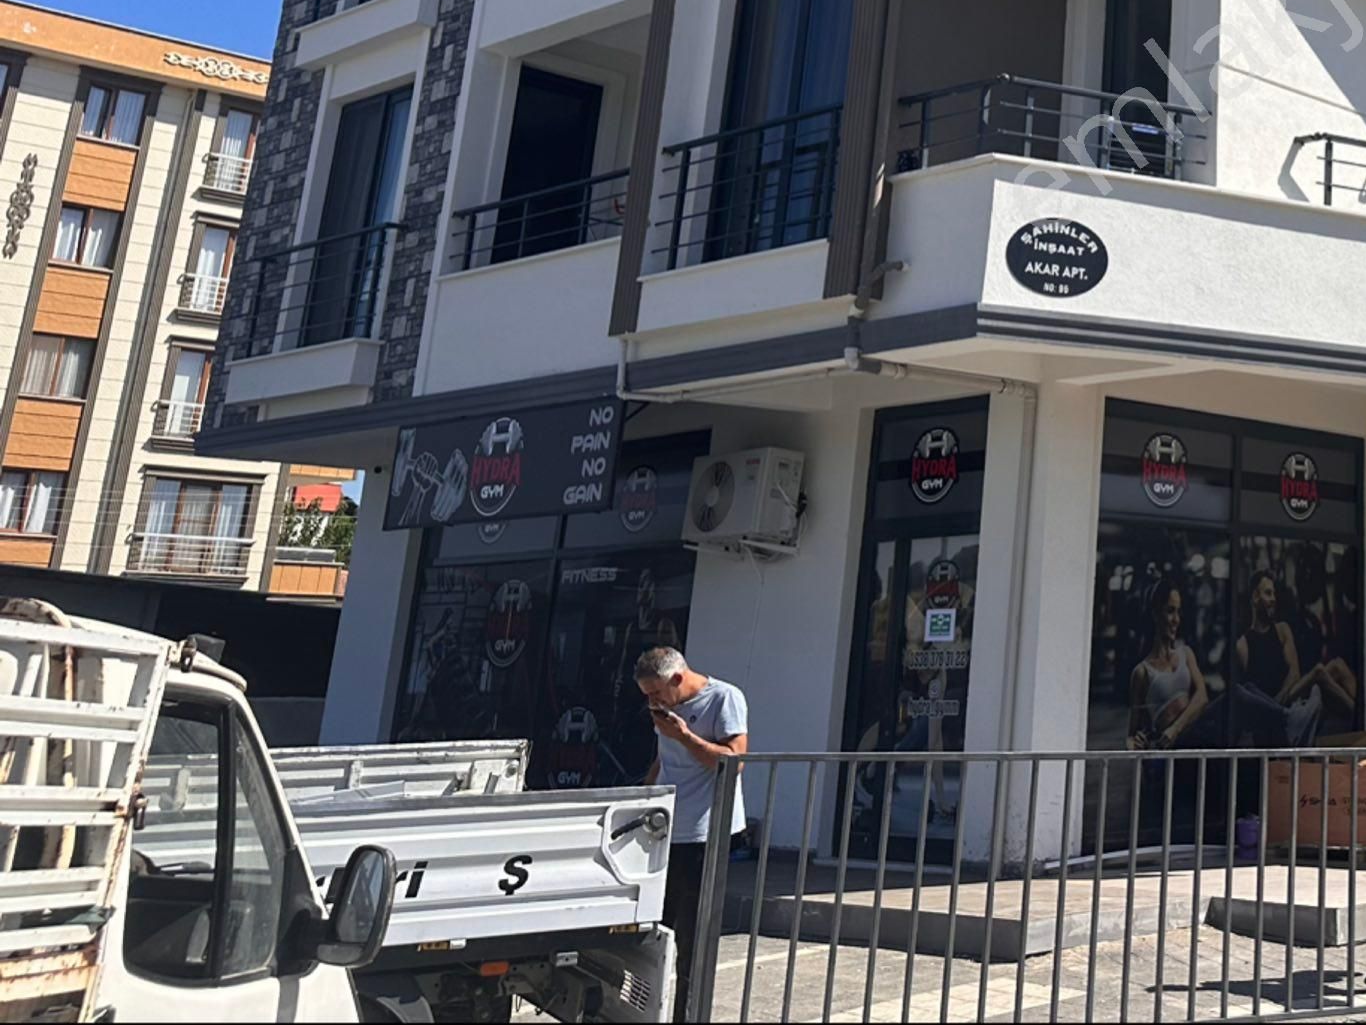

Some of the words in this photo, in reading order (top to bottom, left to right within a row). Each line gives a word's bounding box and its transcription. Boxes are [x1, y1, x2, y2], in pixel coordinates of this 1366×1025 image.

[1025, 262, 1060, 277] AKAR
[1062, 266, 1088, 280] APT.
[589, 406, 614, 427] NO
[570, 432, 611, 454] PAIN
[470, 453, 521, 486] HYDRA
[581, 457, 606, 477] NO
[912, 454, 958, 481] HYDRA
[1142, 458, 1188, 488] HYDRA
[480, 484, 504, 499] GYM
[921, 478, 943, 490] GYM
[1153, 482, 1174, 494] GYM
[1281, 477, 1318, 501] HYDRA
[563, 483, 602, 505] GAIN
[1290, 498, 1308, 508] GYM
[562, 567, 618, 584] FITNESS
[495, 640, 516, 652] GYM
[557, 771, 581, 785] GYM
